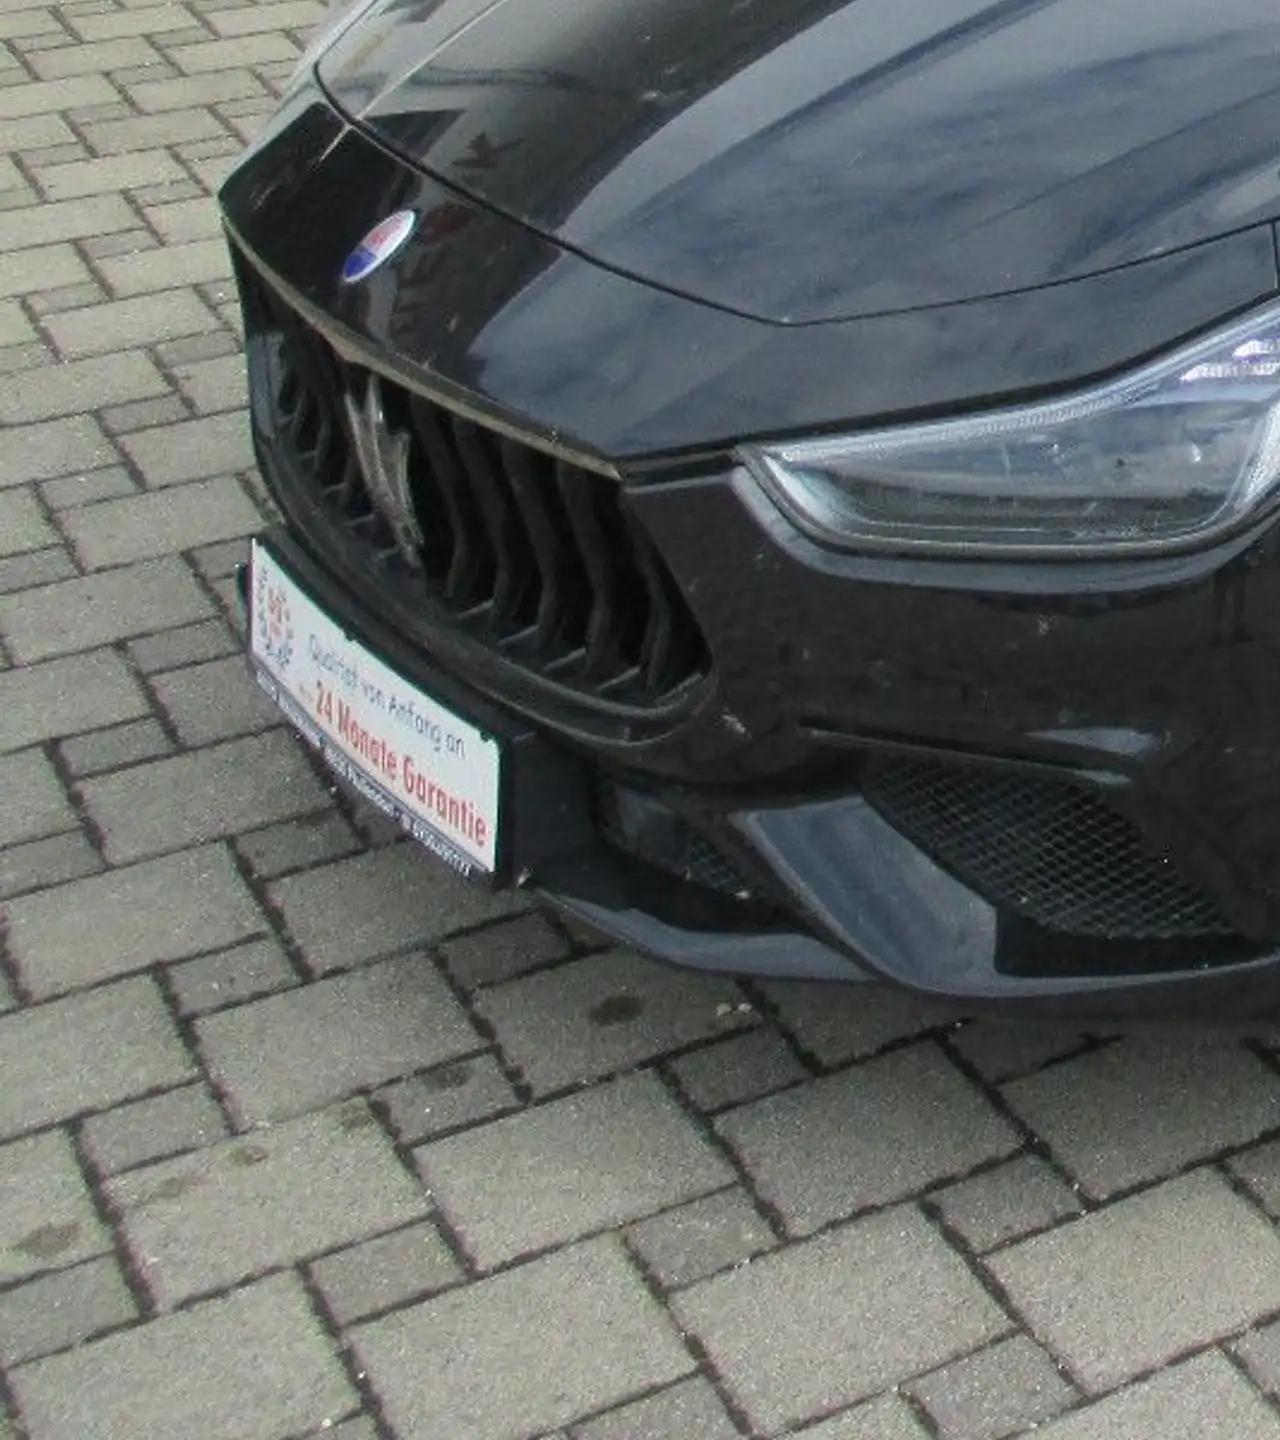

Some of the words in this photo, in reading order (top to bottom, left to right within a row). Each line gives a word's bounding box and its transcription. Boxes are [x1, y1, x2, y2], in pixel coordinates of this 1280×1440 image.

[315, 680, 335, 726] 24
[337, 699, 398, 781] Monate
[402, 754, 488, 850] Garantie
[445, 731, 467, 758] an
